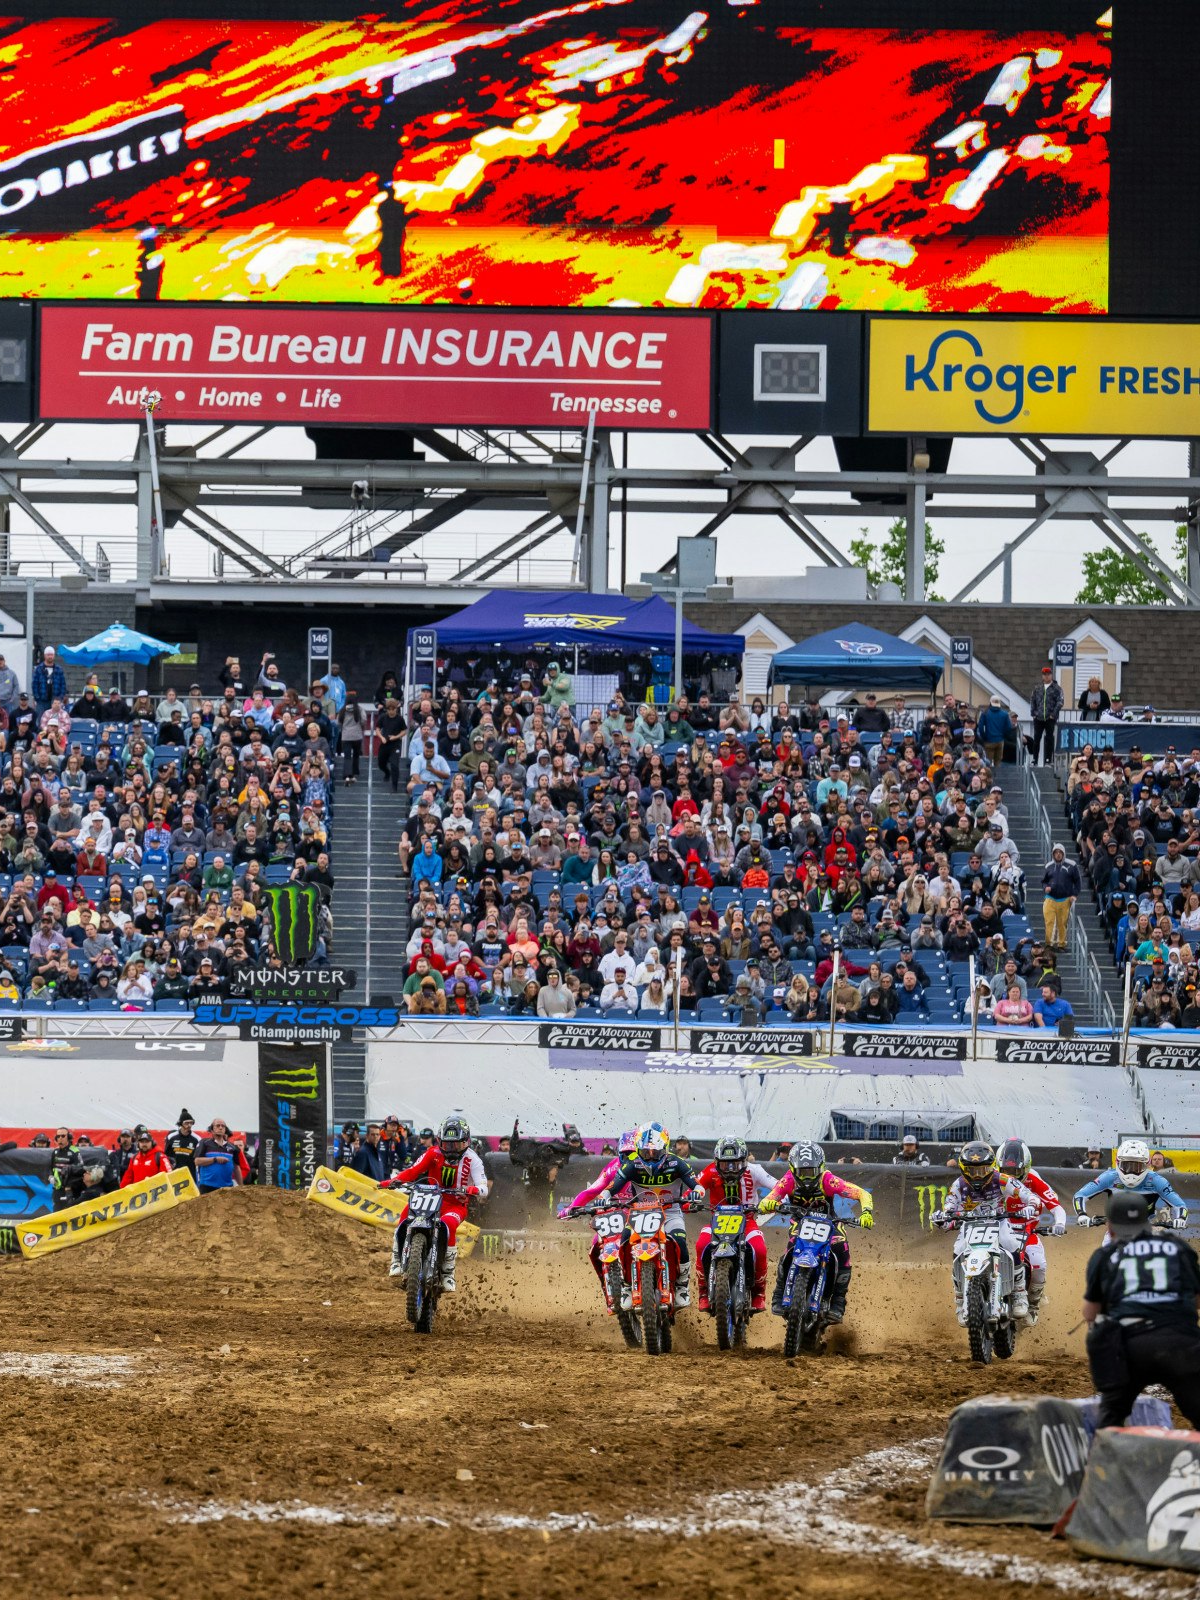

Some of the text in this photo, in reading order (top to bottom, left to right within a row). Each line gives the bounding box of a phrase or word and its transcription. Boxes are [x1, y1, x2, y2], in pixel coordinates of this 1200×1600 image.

[81, 324, 667, 369] Farm Bureau INSURANCE
[906, 330, 1077, 424] Kroger
[1100, 366, 1200, 395] FRESH
[108, 386, 341, 410] Auto Home Life
[550, 393, 662, 414] Tennessee
[312, 633, 328, 644] 146
[417, 635, 433, 645] 101
[953, 641, 969, 652] 101
[1056, 643, 1073, 654] 102
[1073, 729, 1115, 749] TOUGH
[238, 968, 347, 987] MONSTER
[200, 996, 222, 1005] AMA
[254, 989, 330, 997] ENERGY
[195, 1006, 400, 1026] SUPERCROSS
[250, 1025, 341, 1041] Championship
[564, 1026, 653, 1038] ROCKY MOUNTAIN
[715, 1032, 804, 1042] ROCKY MOUNTAIN
[869, 1034, 958, 1047] ROCKY MOUNTAIN
[1022, 1041, 1112, 1052] ROCKY MOUNTAIN
[1164, 1045, 1197, 1056] ROCKY
[411, 1190, 440, 1211] 511
[48, 1183, 168, 1240] DUNLOP
[595, 1214, 625, 1238] 39
[631, 1212, 662, 1233] 16
[714, 1215, 743, 1234] 38
[800, 1220, 831, 1242] 69
[966, 1226, 999, 1244] 166
[1119, 1256, 1168, 1295] 11
[944, 1470, 1036, 1482] OAKLEY
